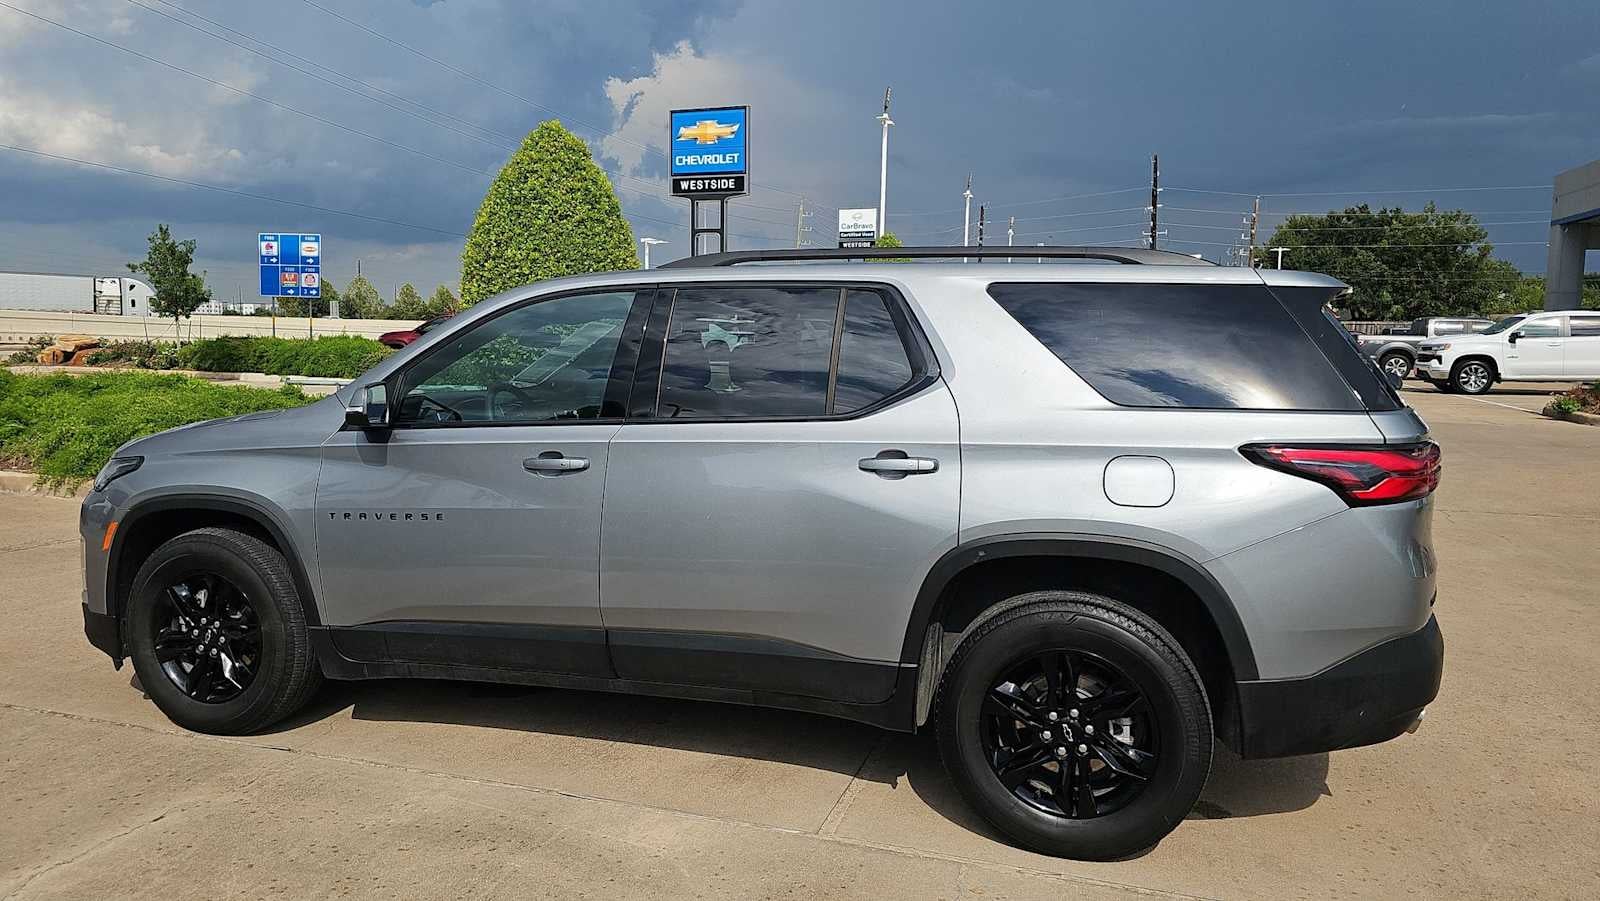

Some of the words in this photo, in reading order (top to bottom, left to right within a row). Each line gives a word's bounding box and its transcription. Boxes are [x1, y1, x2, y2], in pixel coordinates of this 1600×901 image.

[675, 153, 740, 166] CHEVROLET
[680, 179, 736, 190] WESTSIDE
[328, 512, 445, 521] TRAVERSE
